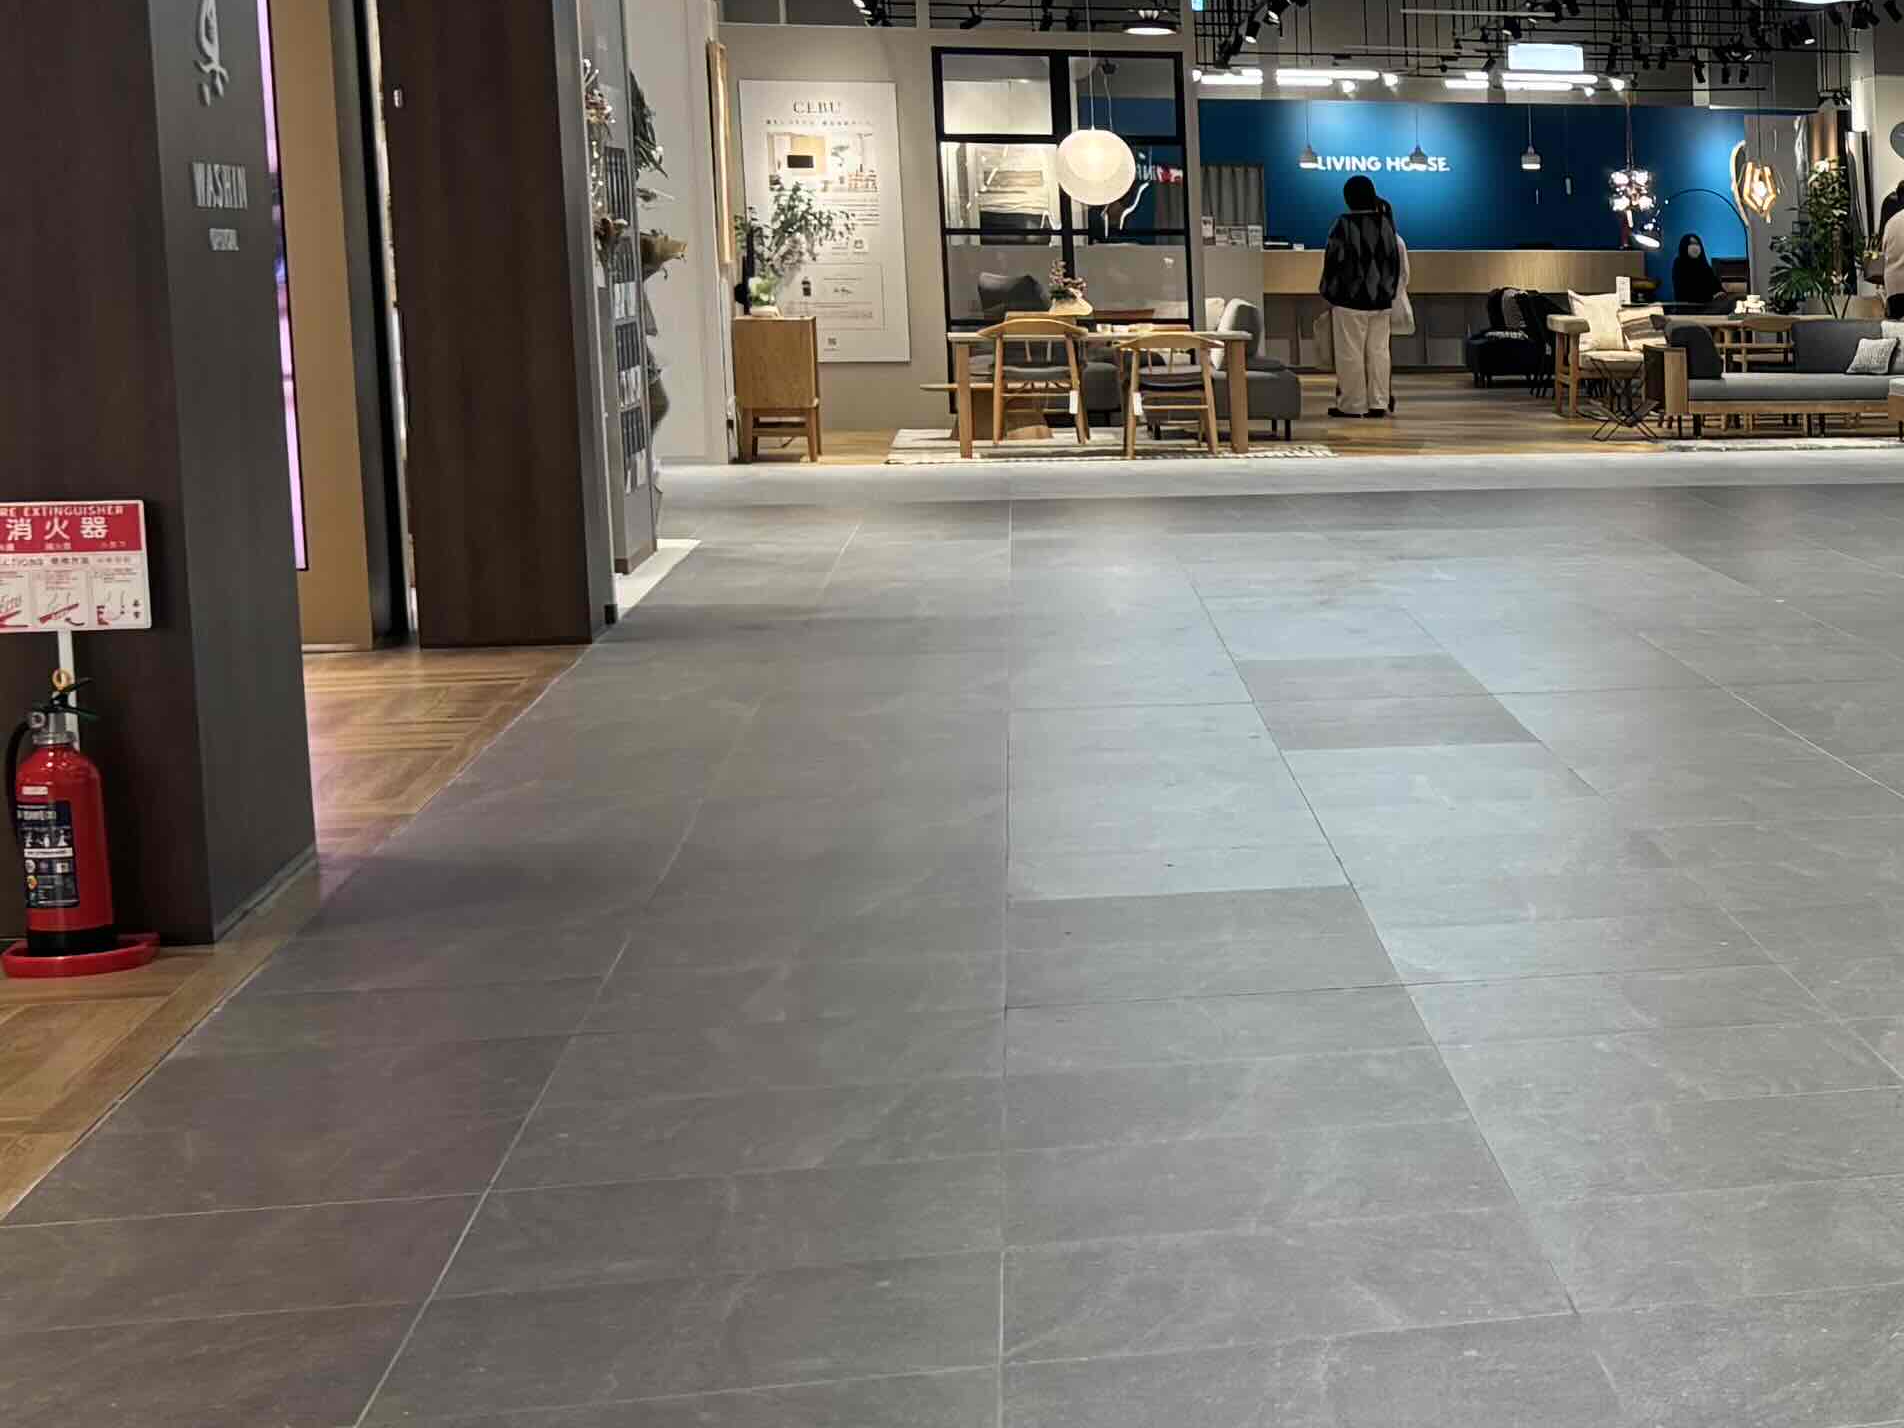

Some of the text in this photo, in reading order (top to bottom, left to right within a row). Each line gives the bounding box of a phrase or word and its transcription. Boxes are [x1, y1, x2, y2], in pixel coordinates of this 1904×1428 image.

[1317, 155, 1382, 172] LIVING
[23, 505, 125, 517] EXTINGUISHER
[6, 516, 109, 541] 消火器
